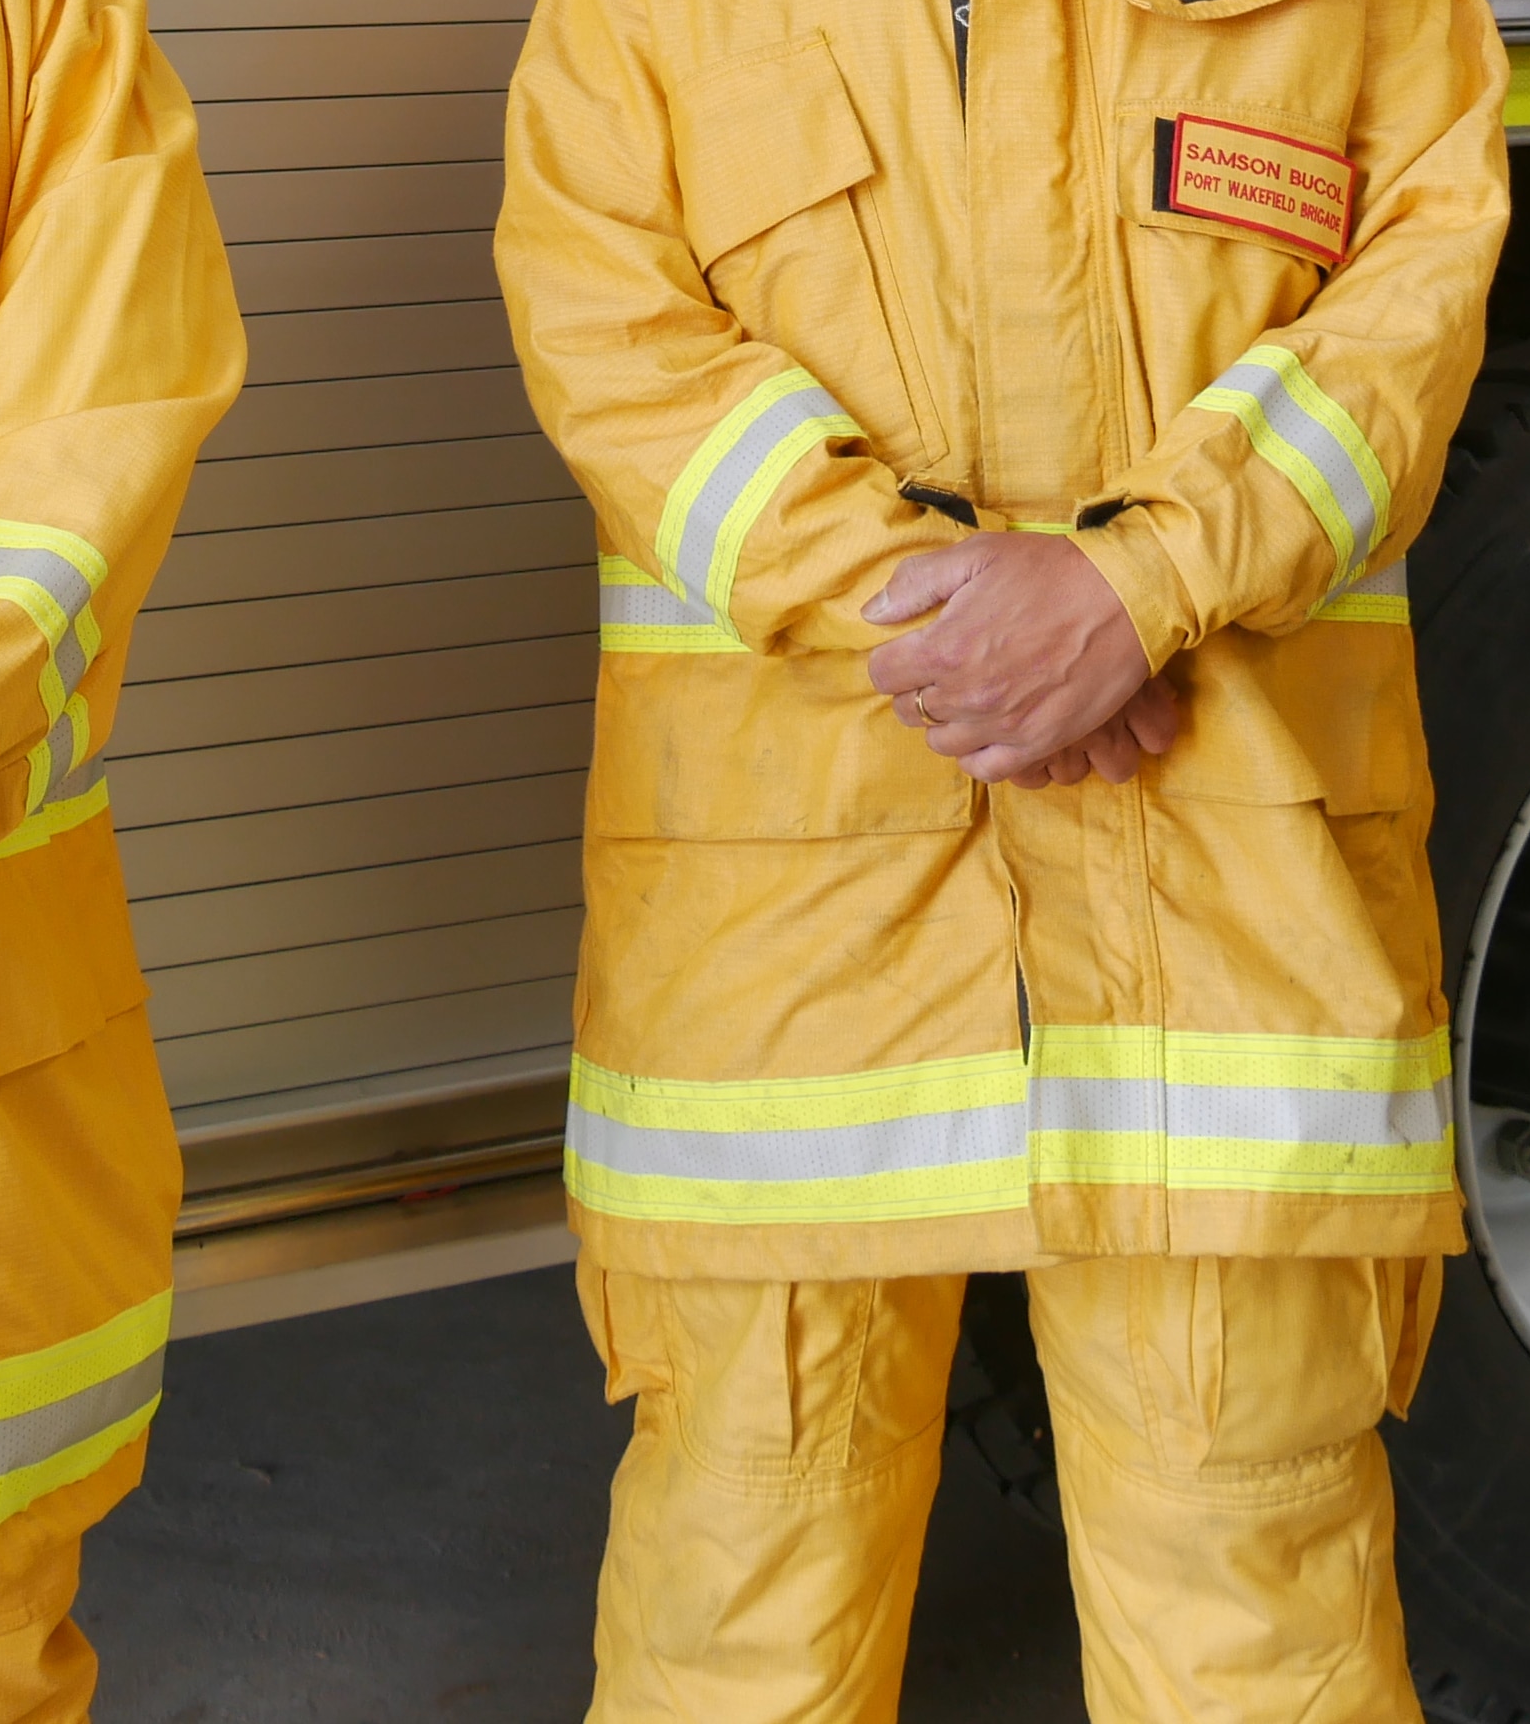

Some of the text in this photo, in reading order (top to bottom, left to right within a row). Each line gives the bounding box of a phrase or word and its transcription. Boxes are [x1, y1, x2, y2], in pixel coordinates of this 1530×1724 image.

[1183, 171, 1342, 234] PORT WAKEFIELD BRIGADE
[1185, 143, 1344, 206] SAMSON BUCOL
